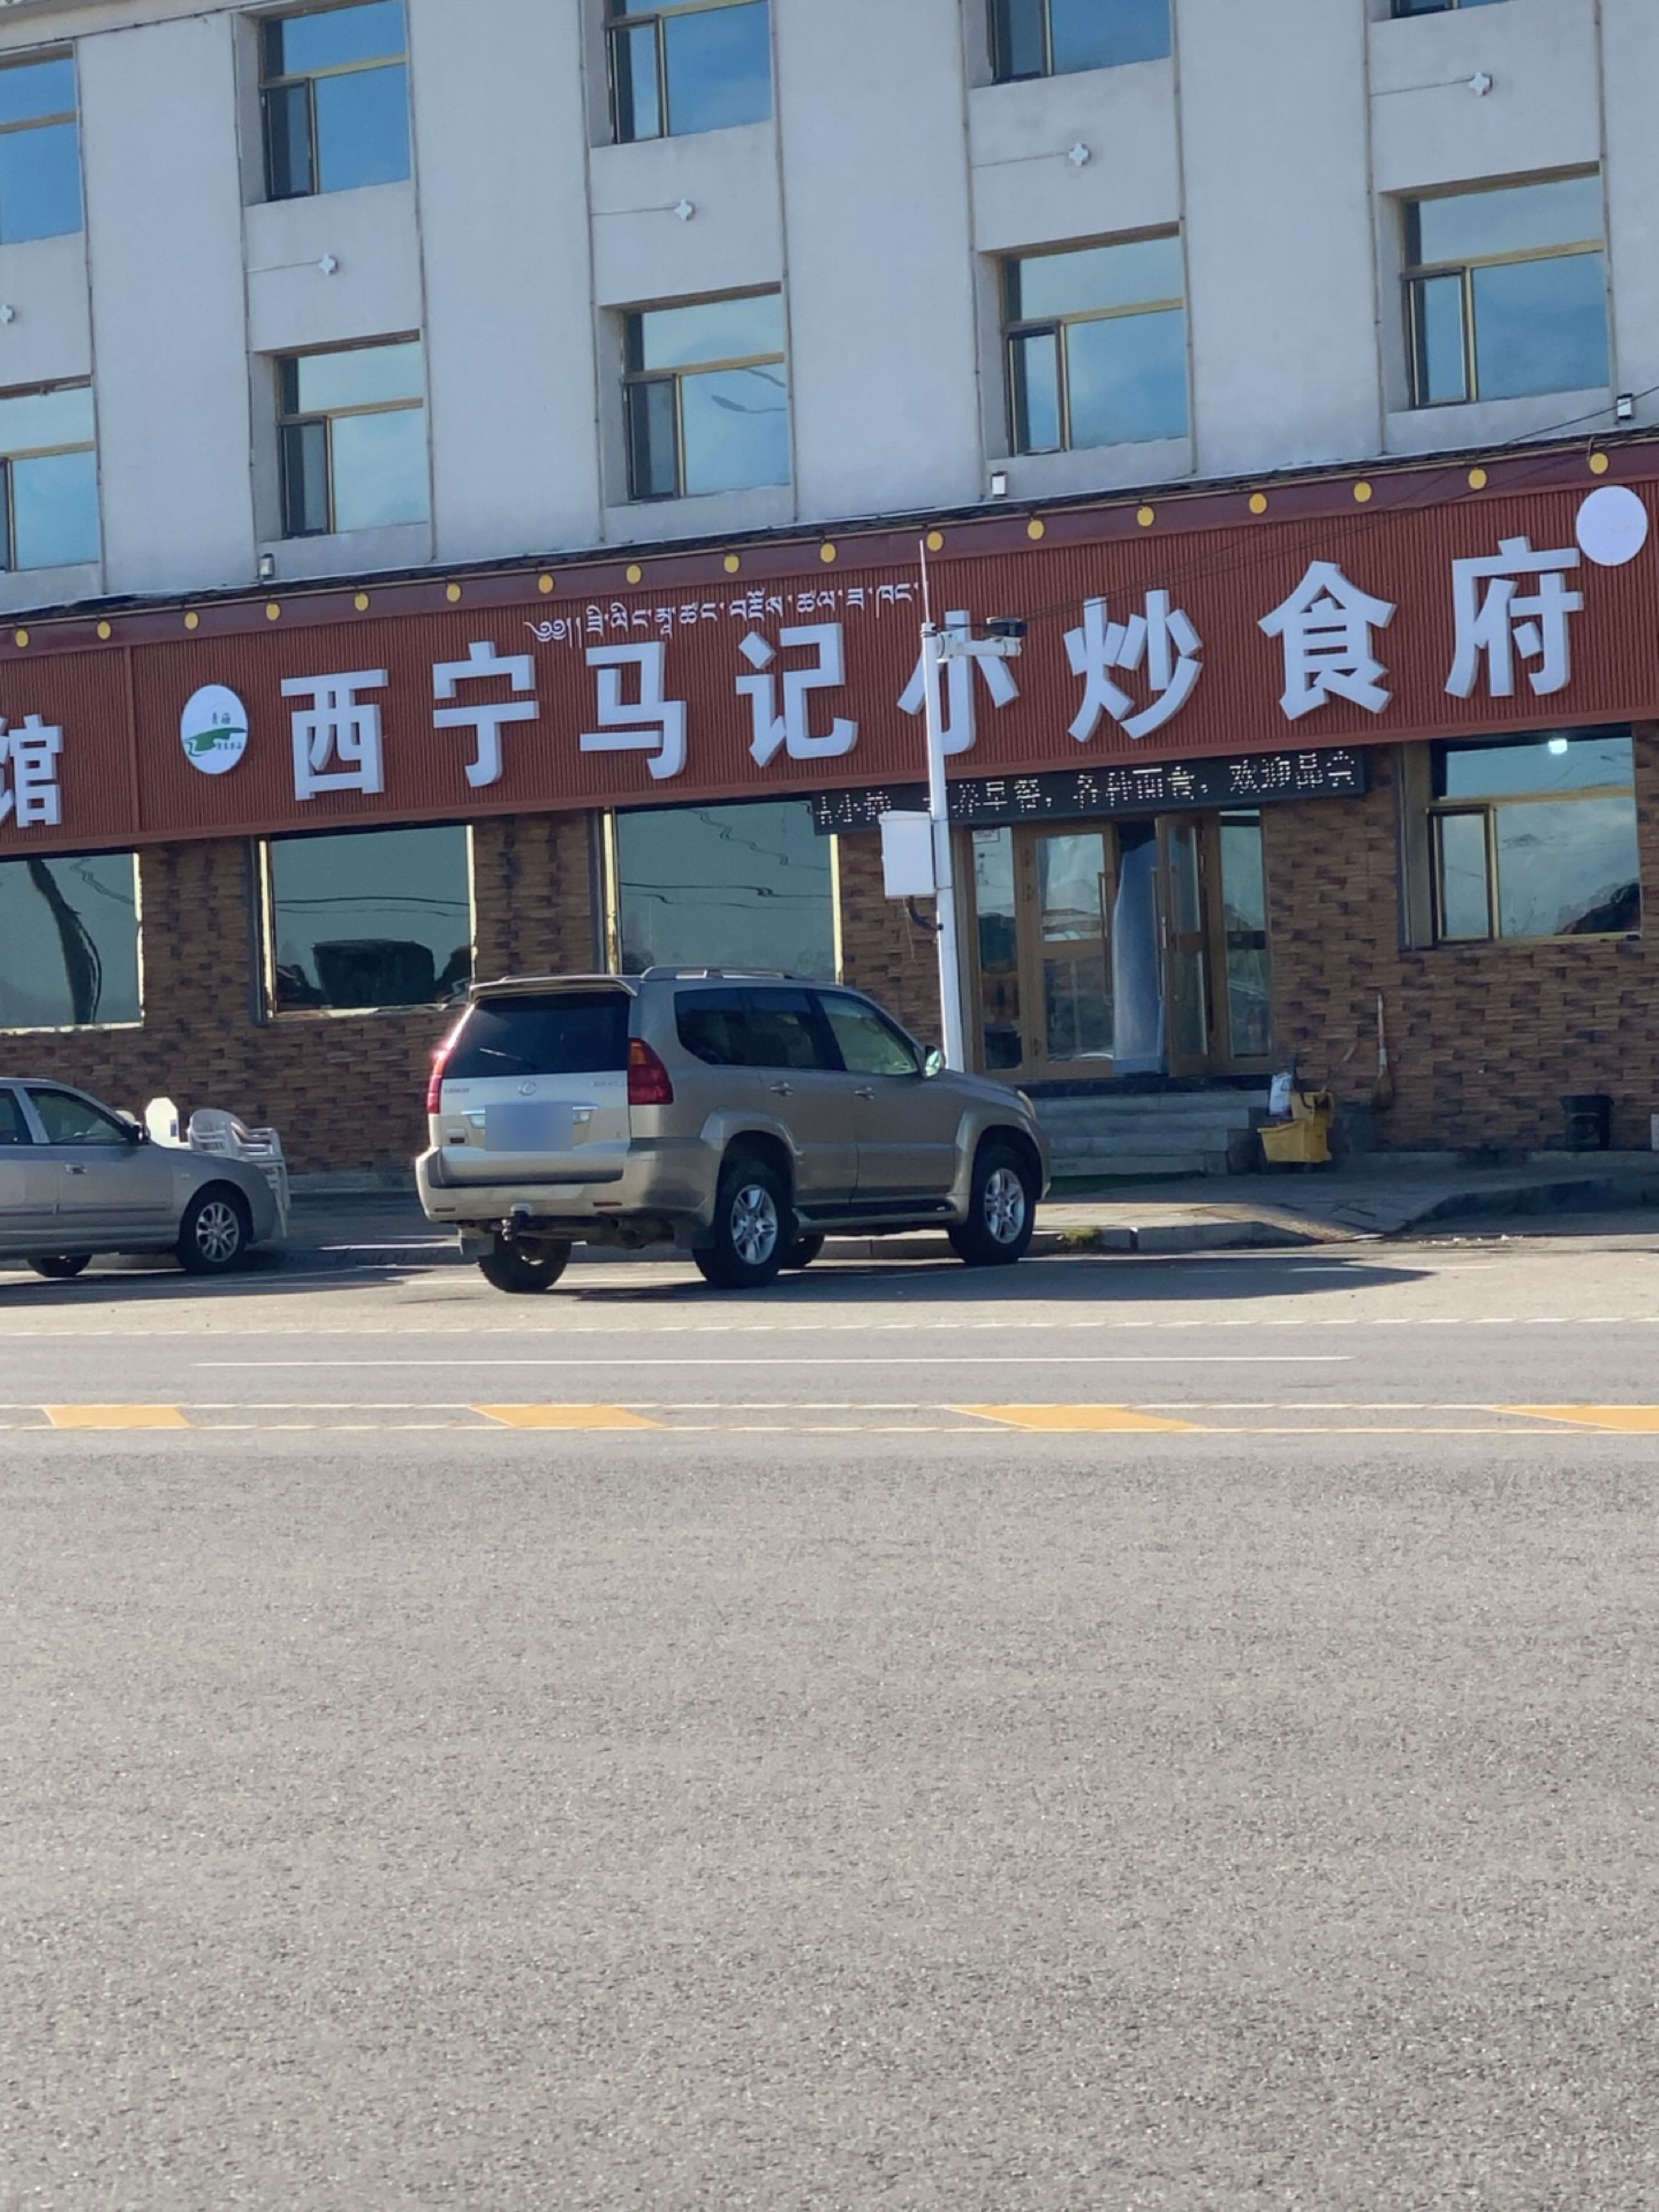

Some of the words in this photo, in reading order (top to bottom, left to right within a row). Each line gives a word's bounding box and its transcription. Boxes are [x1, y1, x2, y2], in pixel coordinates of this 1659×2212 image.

[280, 535, 1584, 801] 西宁马记小炒食府
[0, 714, 62, 828] 馆
